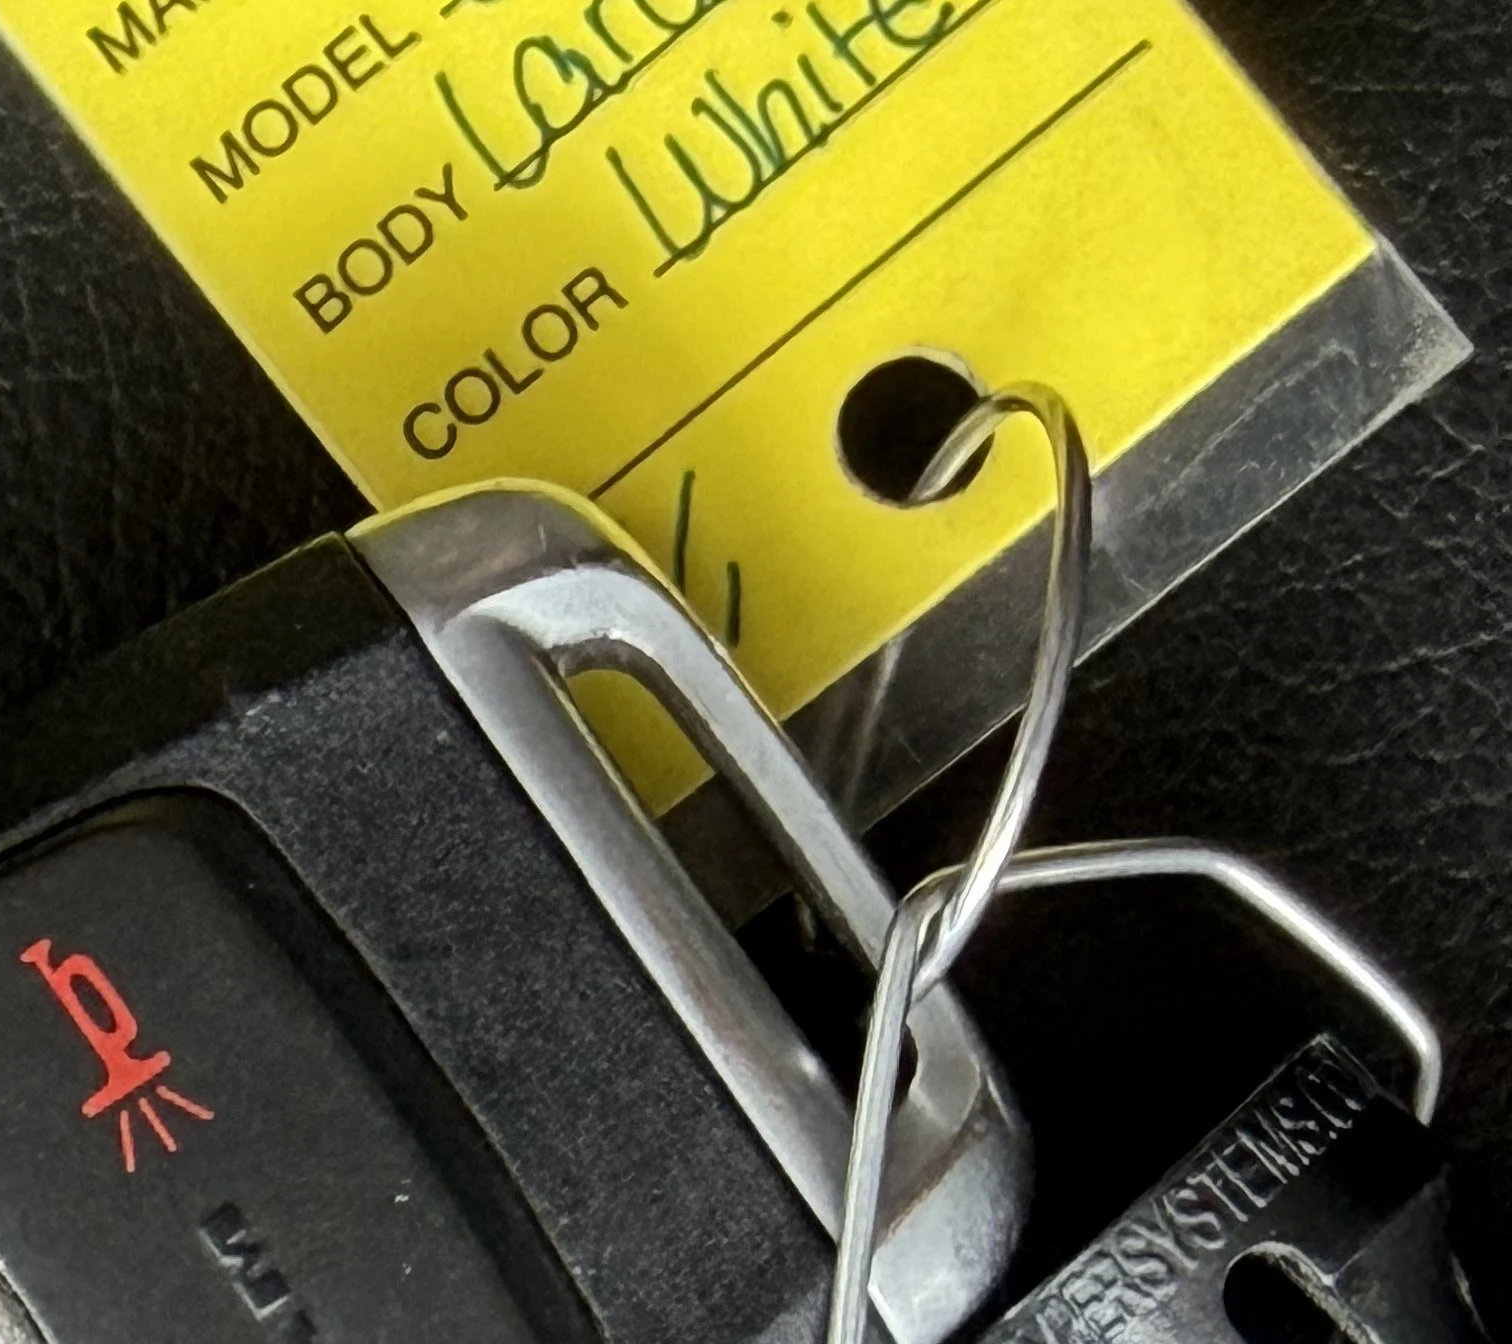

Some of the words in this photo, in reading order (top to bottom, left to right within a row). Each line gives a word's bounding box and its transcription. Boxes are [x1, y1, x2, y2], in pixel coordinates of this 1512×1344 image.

[190, 13, 421, 205] MODEL
[292, 164, 472, 335] BODY
[403, 266, 629, 462] COLOR
